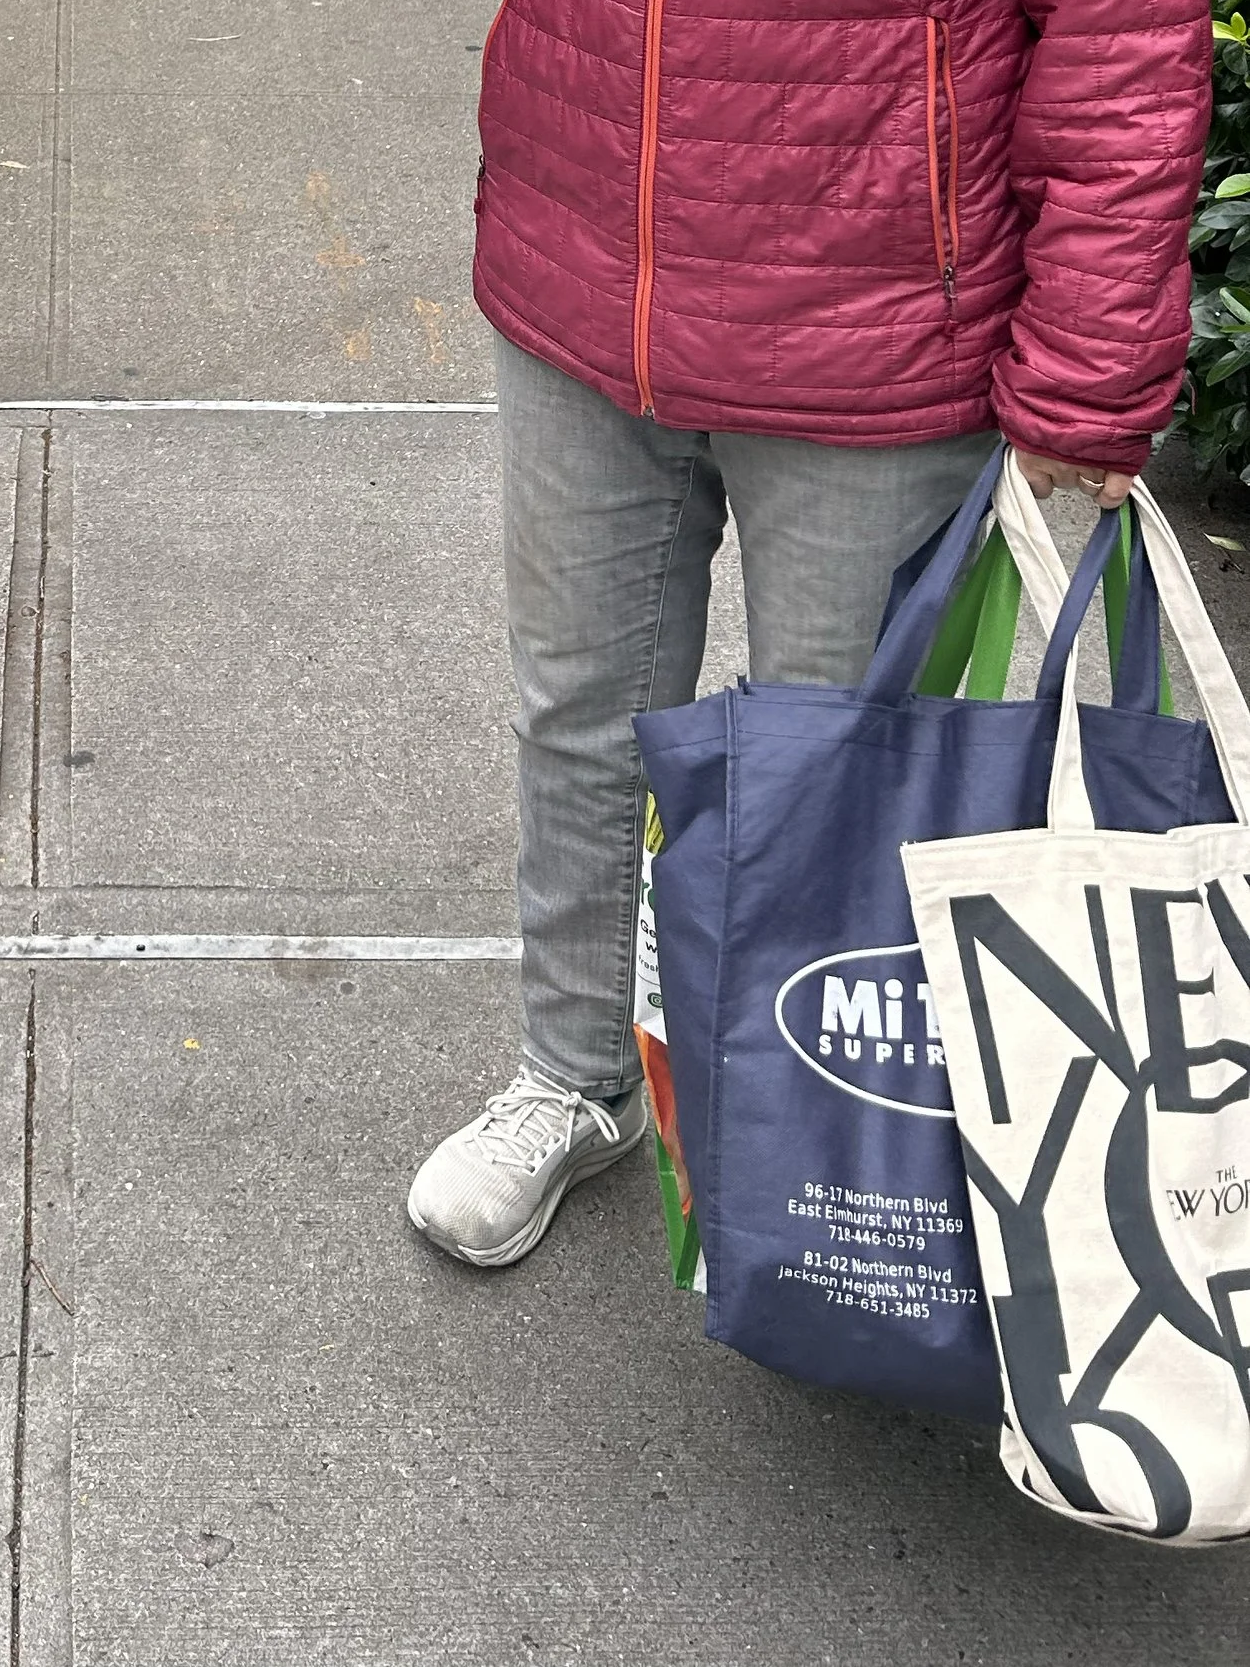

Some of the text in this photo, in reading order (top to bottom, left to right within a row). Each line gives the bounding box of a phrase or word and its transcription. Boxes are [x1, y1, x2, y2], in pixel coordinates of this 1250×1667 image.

[821, 974, 904, 1040] Mi
[818, 1034, 946, 1066] SUPER
[1215, 1165, 1237, 1183] THE
[804, 1181, 948, 1214] 96-17 Northern Blvd
[787, 1198, 964, 1233] East Elmhurst, NY 11369
[828, 1224, 926, 1251] 718-446-0579
[803, 1250, 952, 1284] 81-02 Northern Blvd
[777, 1264, 978, 1305] Jackson Heights, NY 11372
[825, 1289, 930, 1319] 718-651-3485
